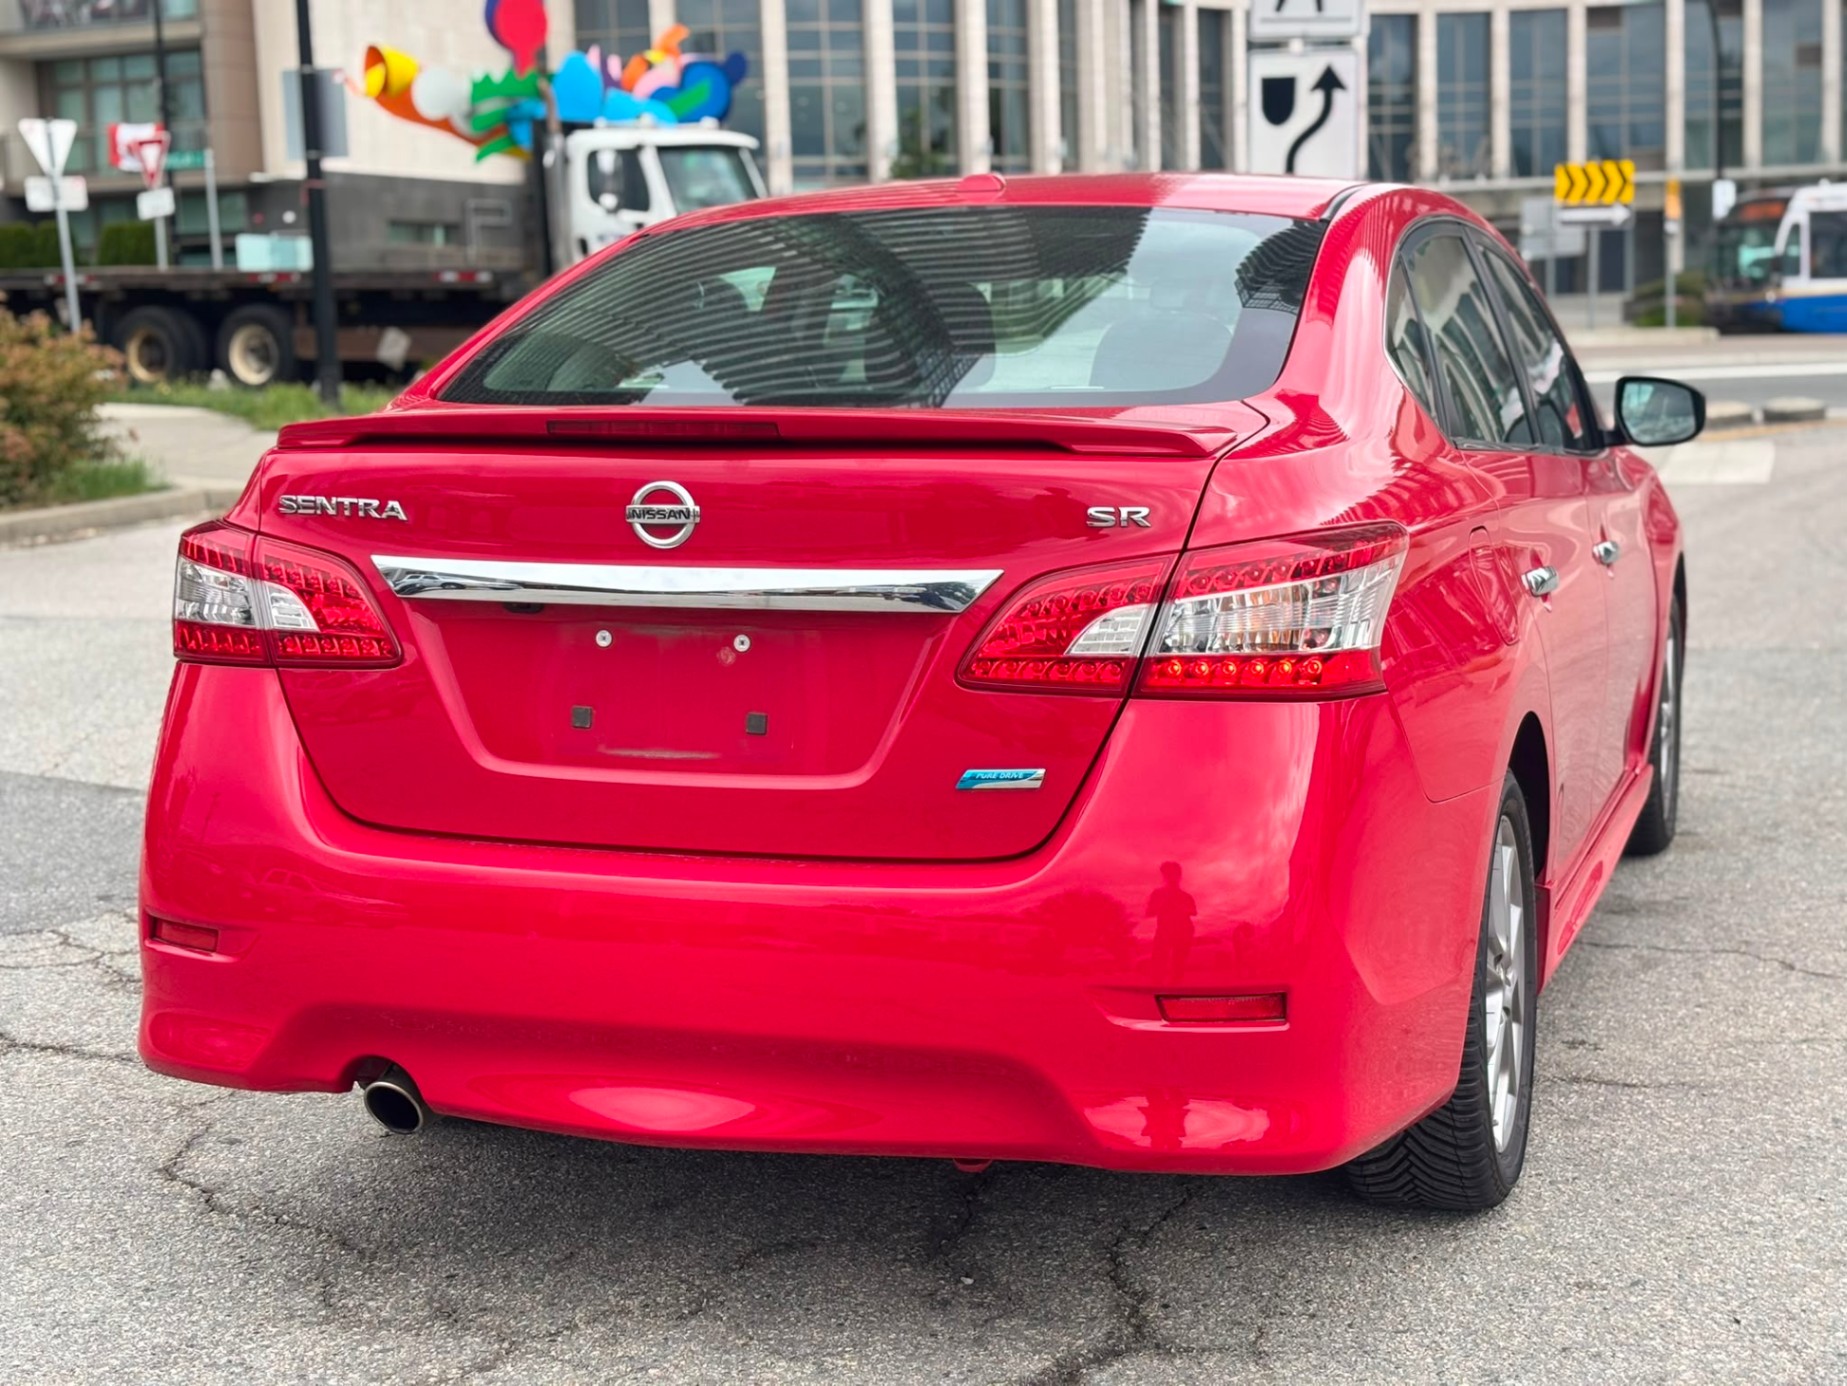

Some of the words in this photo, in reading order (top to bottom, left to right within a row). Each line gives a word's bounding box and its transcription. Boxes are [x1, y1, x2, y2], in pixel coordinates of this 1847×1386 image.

[278, 494, 408, 521] SENTRA
[631, 508, 691, 520] NISSAN
[1085, 505, 1151, 528] SR
[975, 771, 998, 779] PURE
[999, 771, 1024, 779] DRIVE
